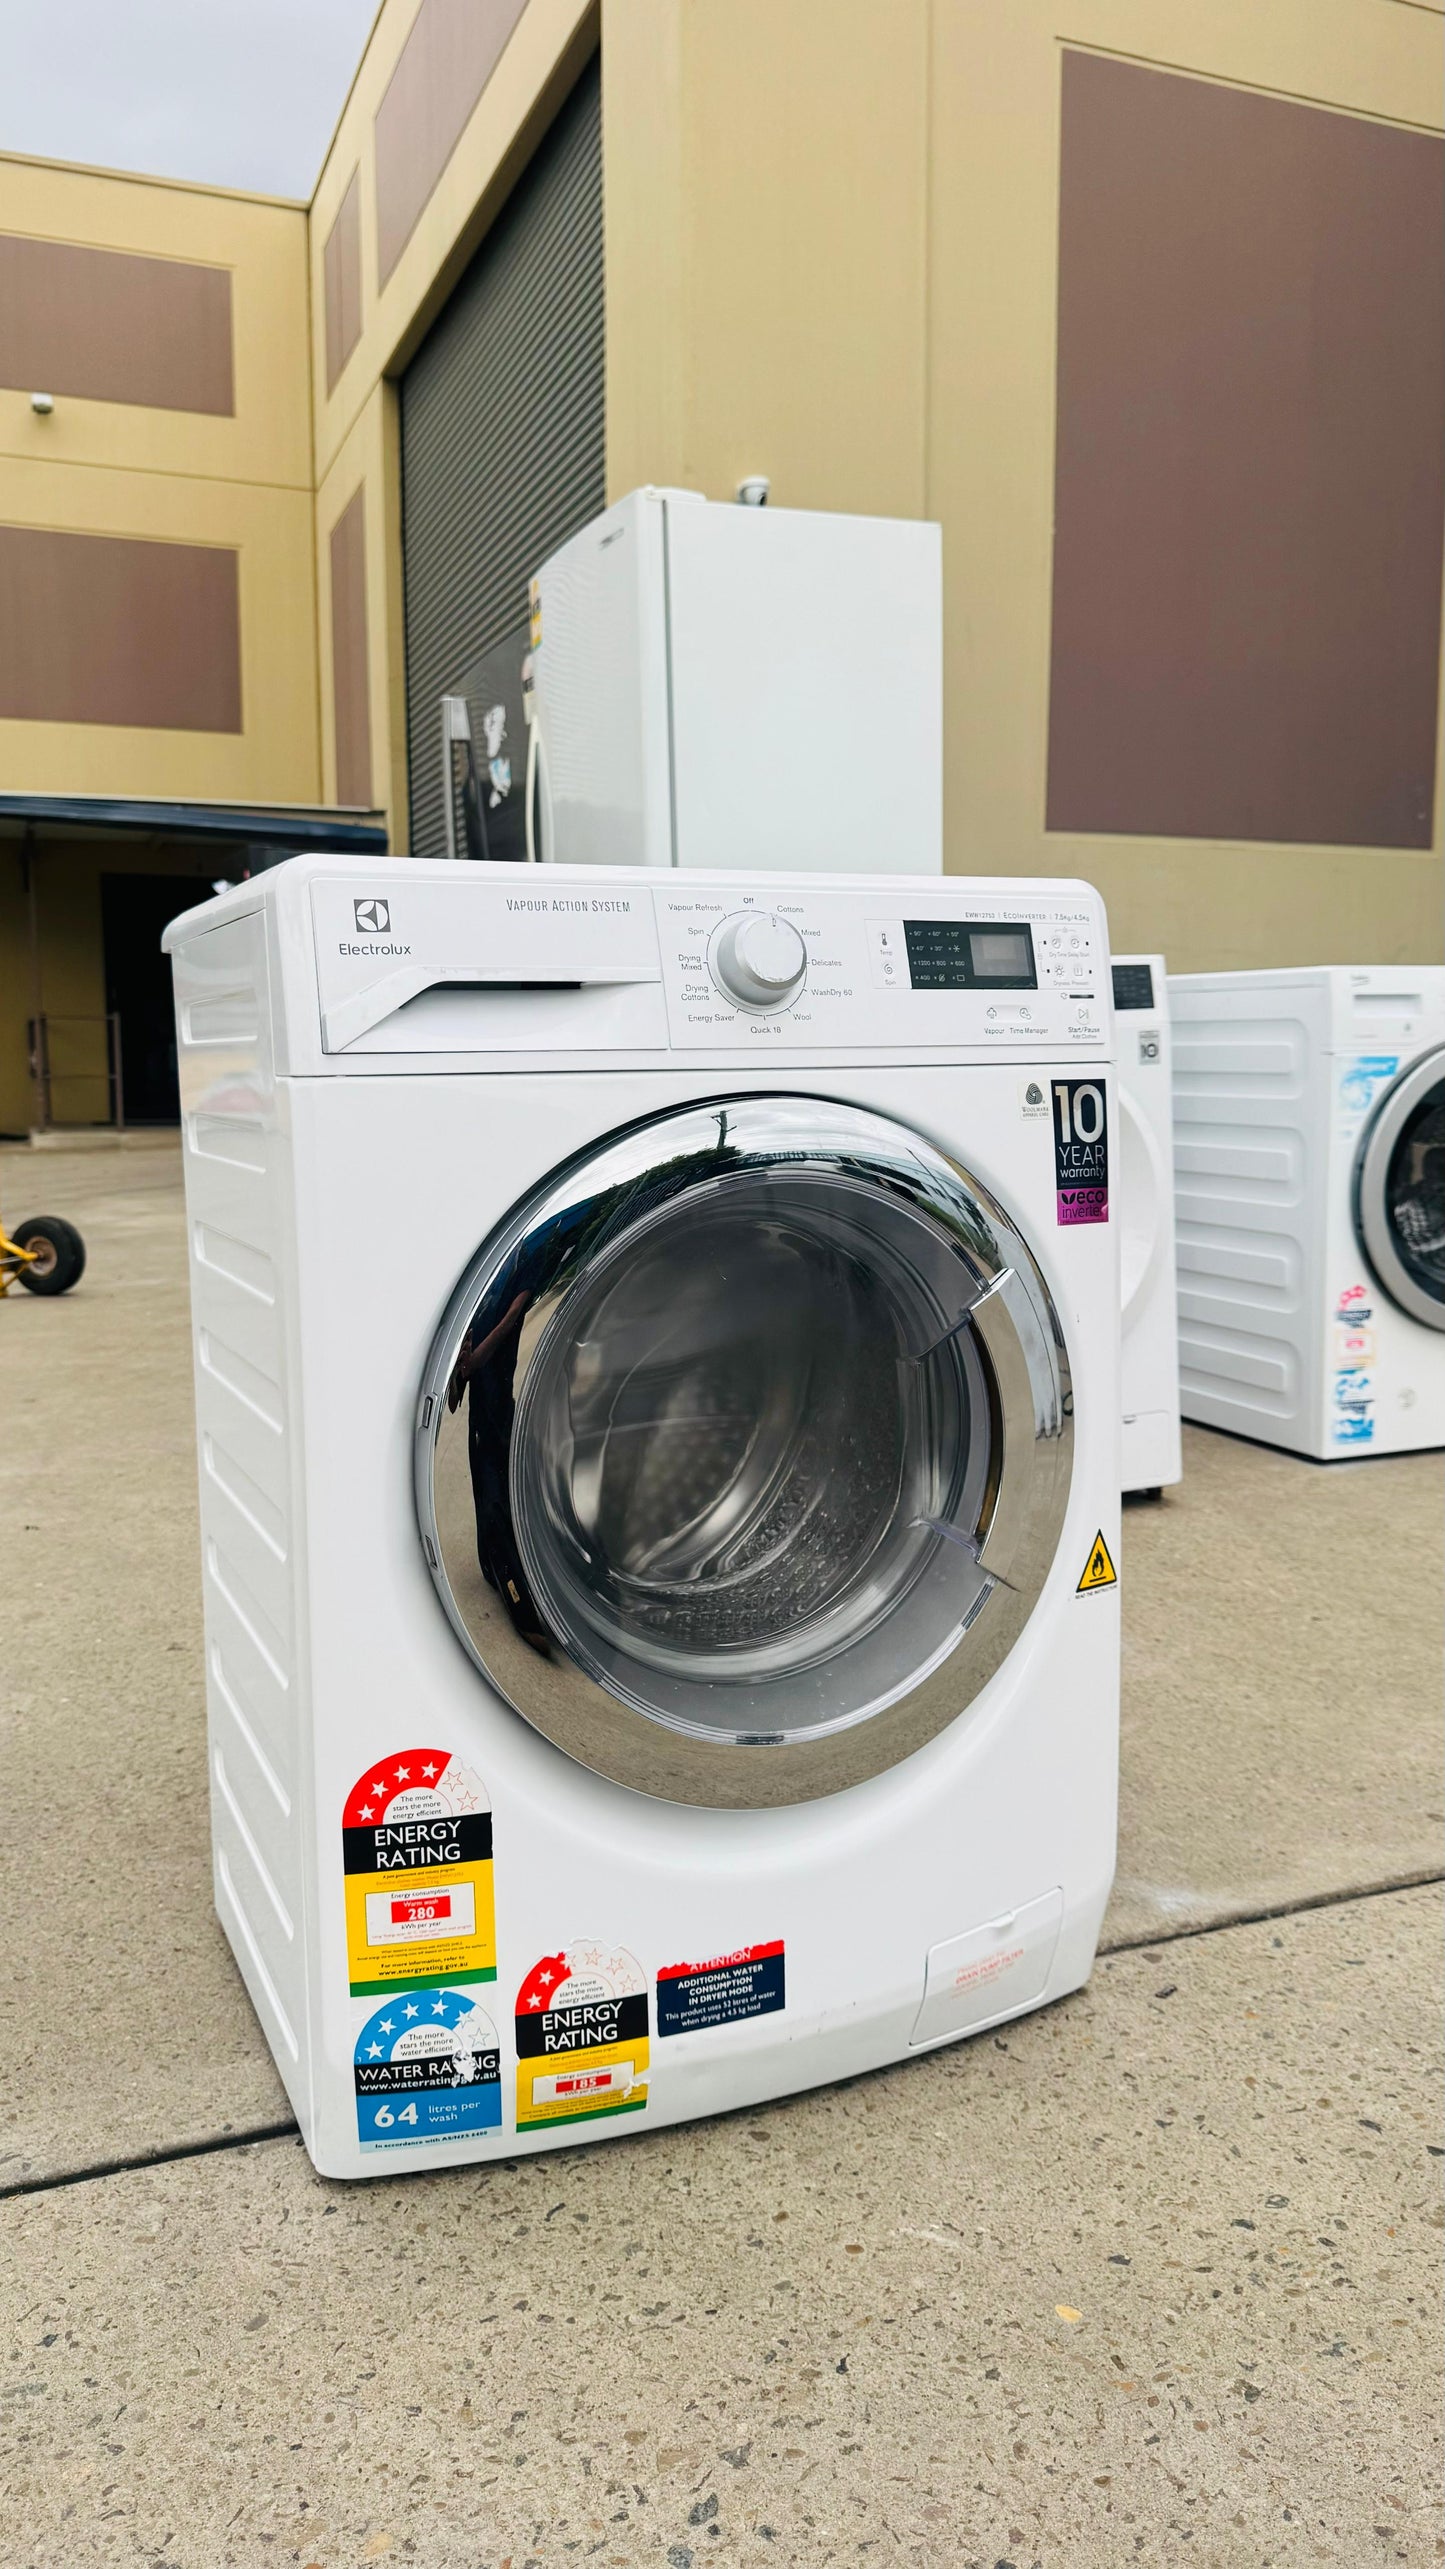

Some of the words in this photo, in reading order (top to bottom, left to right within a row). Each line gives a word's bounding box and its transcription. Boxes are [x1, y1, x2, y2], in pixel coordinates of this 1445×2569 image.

[506, 899, 549, 913] VAPOUR
[551, 900, 589, 913] ACTION
[591, 900, 631, 914] SYSTEM
[668, 904, 694, 912] Vapour
[695, 904, 722, 912] Refresh
[777, 905, 804, 914] Cottons
[688, 928, 704, 936] Spin
[801, 928, 821, 937] Mixed
[338, 942, 412, 957] Electrolux
[678, 954, 701, 963] Drying
[811, 959, 842, 967] Delicates
[681, 963, 703, 971] Mixed
[686, 985, 709, 993] Drying
[811, 989, 842, 997] WashDry
[681, 993, 710, 1001] Cottons
[688, 1014, 714, 1023] Energy
[714, 1014, 735, 1022] Saver
[793, 1013, 812, 1021] Wool
[750, 1026, 772, 1035] Quick
[984, 1027, 1005, 1035] Vapour
[1024, 1027, 1049, 1035] Manager
[1055, 1084, 1104, 1143] 10
[1059, 1145, 1105, 1166] YEAR
[1060, 1166, 1105, 1179] warranty
[1076, 1190, 1105, 1205] eco
[392, 1813, 415, 1821] energy
[416, 1809, 442, 1817] efficient
[374, 1820, 461, 1847] ENERGY
[376, 1843, 461, 1869] RATING
[412, 1888, 450, 1897] consumption
[404, 1900, 423, 1908] Warm
[408, 1906, 435, 1921] 280
[401, 1923, 416, 1931] kWh
[418, 1922, 428, 1930] per
[429, 1920, 442, 1929] year
[677, 1972, 731, 1990] ADDITIONAL
[732, 1963, 763, 1977] WATER
[580, 1979, 597, 1988] more
[689, 1976, 753, 1997] CONSUMPTION
[559, 1989, 575, 1998] stars
[576, 1987, 587, 1995] the
[587, 1985, 604, 1994] more
[688, 1997, 698, 2006] IN
[699, 1991, 728, 2004] DRYER
[729, 1984, 753, 1998] MODE
[558, 1996, 581, 2006] energy
[665, 2012, 679, 2021] This
[680, 2006, 707, 2019] product
[707, 2004, 721, 2012] uses
[733, 1996, 749, 2007] litres
[750, 1993, 757, 2002] of
[758, 1990, 776, 2001] water
[541, 2001, 624, 2032] ENERGY
[681, 2017, 700, 2027] when
[700, 2011, 721, 2024] drying
[739, 2005, 747, 2014] kg
[747, 2002, 761, 2011] load
[408, 2033, 424, 2041] The
[425, 2031, 445, 2039] more
[544, 2024, 618, 2052] RATING
[400, 2041, 417, 2049] stars
[419, 2039, 432, 2047] the
[433, 2037, 454, 2046] more
[424, 2046, 454, 2055] efficient
[358, 2063, 424, 2081] WATER
[428, 2054, 496, 2076] RANG
[572, 2076, 597, 2091] 185
[428, 2104, 458, 2114] litres
[461, 2101, 481, 2113] per
[374, 2102, 419, 2129] 64
[429, 2112, 458, 2124] wash
[384, 2139, 423, 2149] accordance
